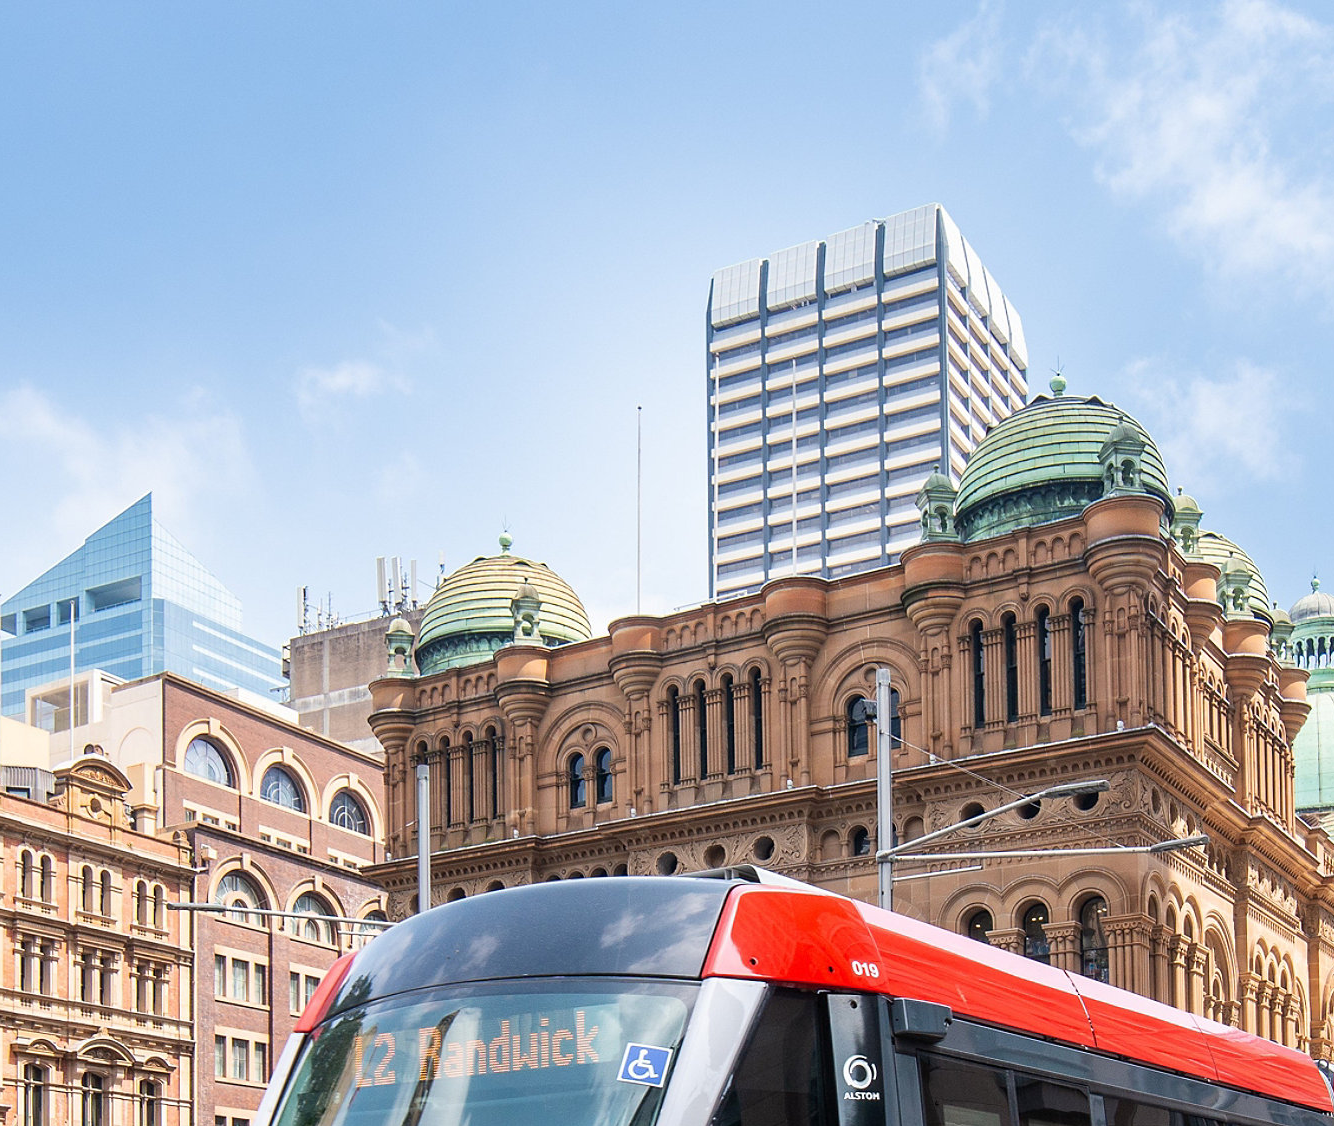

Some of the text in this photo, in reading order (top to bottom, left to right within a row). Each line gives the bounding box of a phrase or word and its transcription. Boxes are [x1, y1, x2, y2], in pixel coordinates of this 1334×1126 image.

[851, 960, 880, 978] 019
[354, 1010, 599, 1088] L2 Randwick
[843, 1091, 881, 1101] ALSTOM
